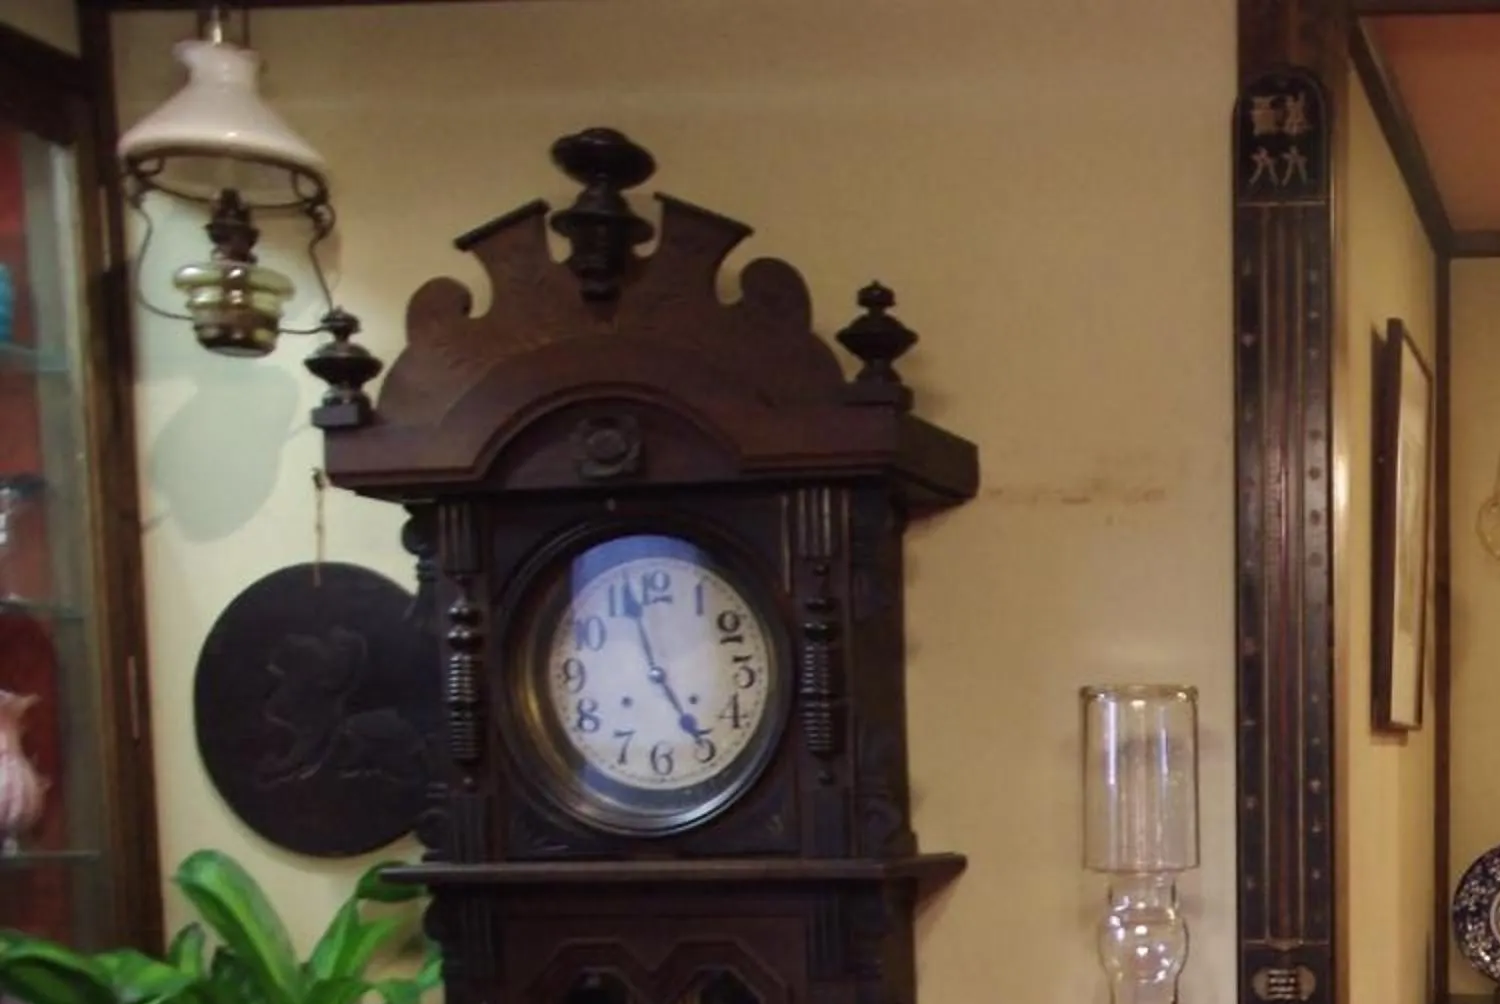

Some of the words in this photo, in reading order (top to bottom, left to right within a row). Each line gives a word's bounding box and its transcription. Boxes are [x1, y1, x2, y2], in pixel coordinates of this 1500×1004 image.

[642, 569, 673, 606] 12
[695, 583, 705, 617] 1
[574, 616, 607, 652] 10
[717, 609, 744, 645] 2
[563, 657, 586, 694] 9
[732, 654, 756, 690] 3
[576, 697, 601, 733] 8
[718, 692, 749, 730] 4
[613, 730, 636, 765] 7
[651, 740, 675, 776] 6
[696, 728, 717, 763] 5
